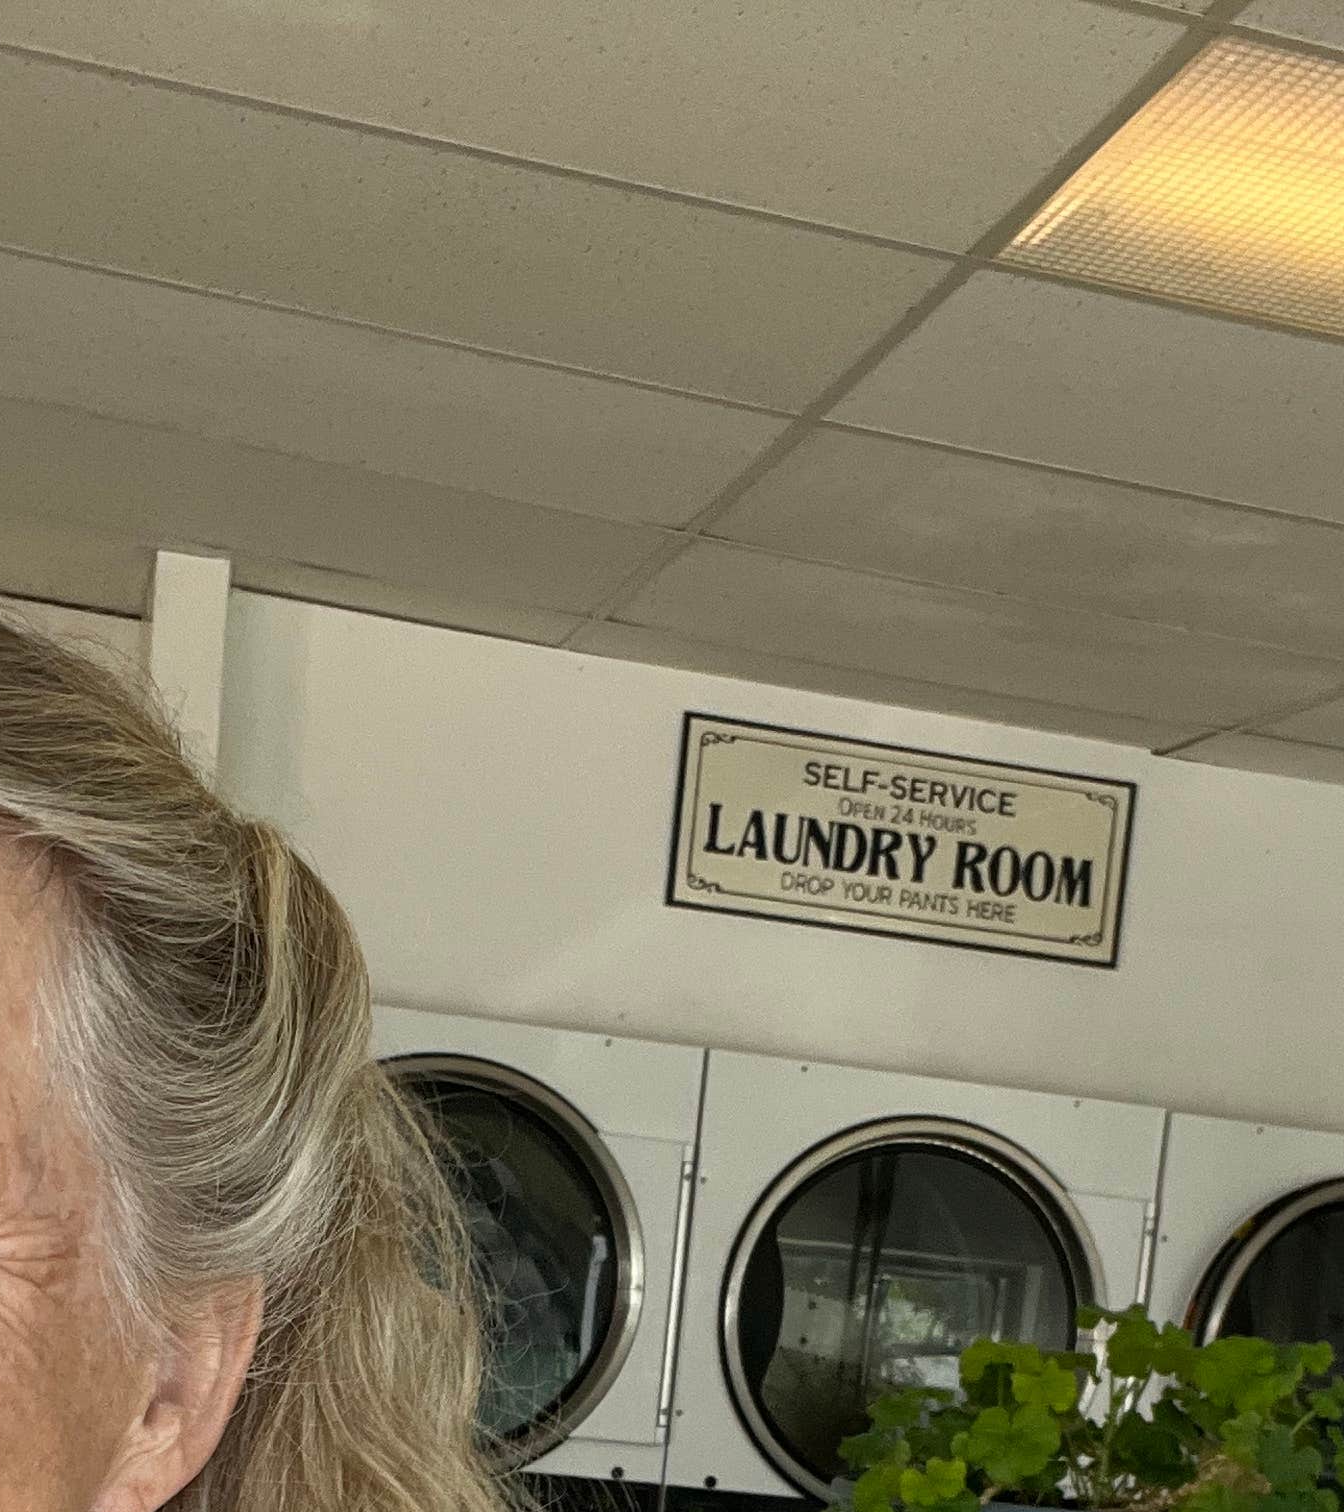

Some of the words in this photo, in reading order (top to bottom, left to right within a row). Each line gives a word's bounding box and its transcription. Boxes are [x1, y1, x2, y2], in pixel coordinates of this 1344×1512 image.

[803, 761, 1017, 817] SELF-SERVICE
[838, 797, 885, 820] OPEN
[890, 805, 914, 824] 24
[919, 809, 978, 836] HOURS
[703, 803, 937, 883] LAUNDRY
[952, 841, 1093, 908] ROOM
[780, 870, 835, 895] DROP
[842, 879, 893, 907] YOUR
[899, 887, 960, 915] PANTS
[966, 901, 1018, 924] HERE
